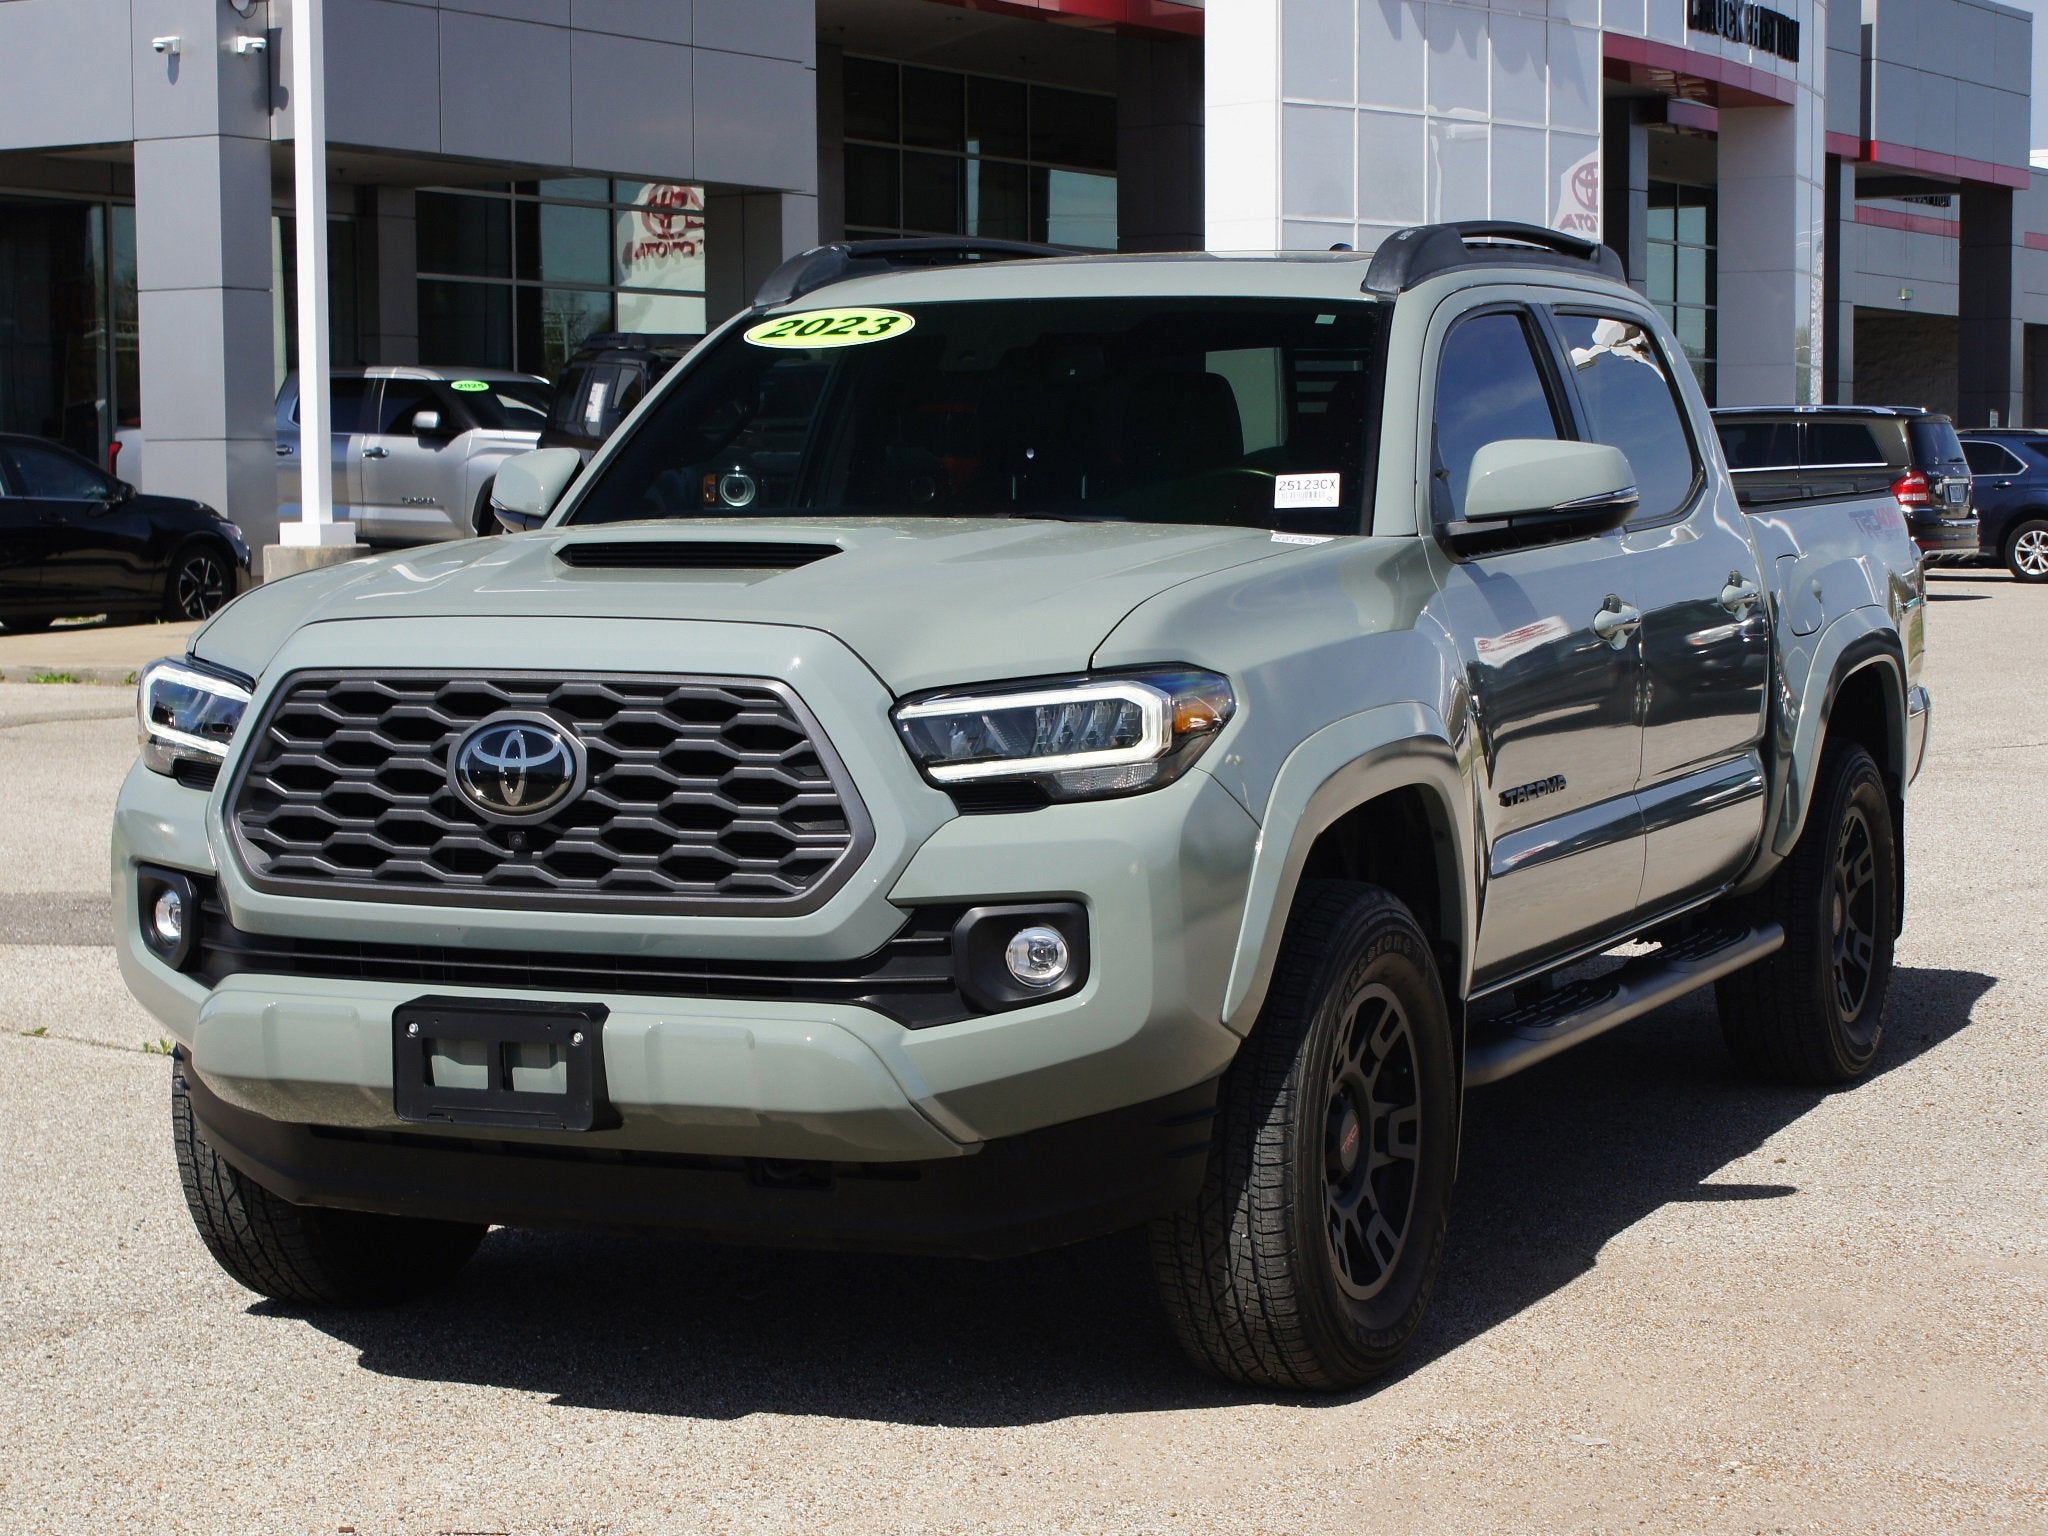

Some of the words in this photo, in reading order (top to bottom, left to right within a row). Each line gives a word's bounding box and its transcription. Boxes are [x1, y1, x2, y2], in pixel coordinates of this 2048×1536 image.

[758, 316, 900, 340] 2023
[1278, 479, 1337, 491] 25123CX
[1498, 775, 1567, 807] TACOMA
